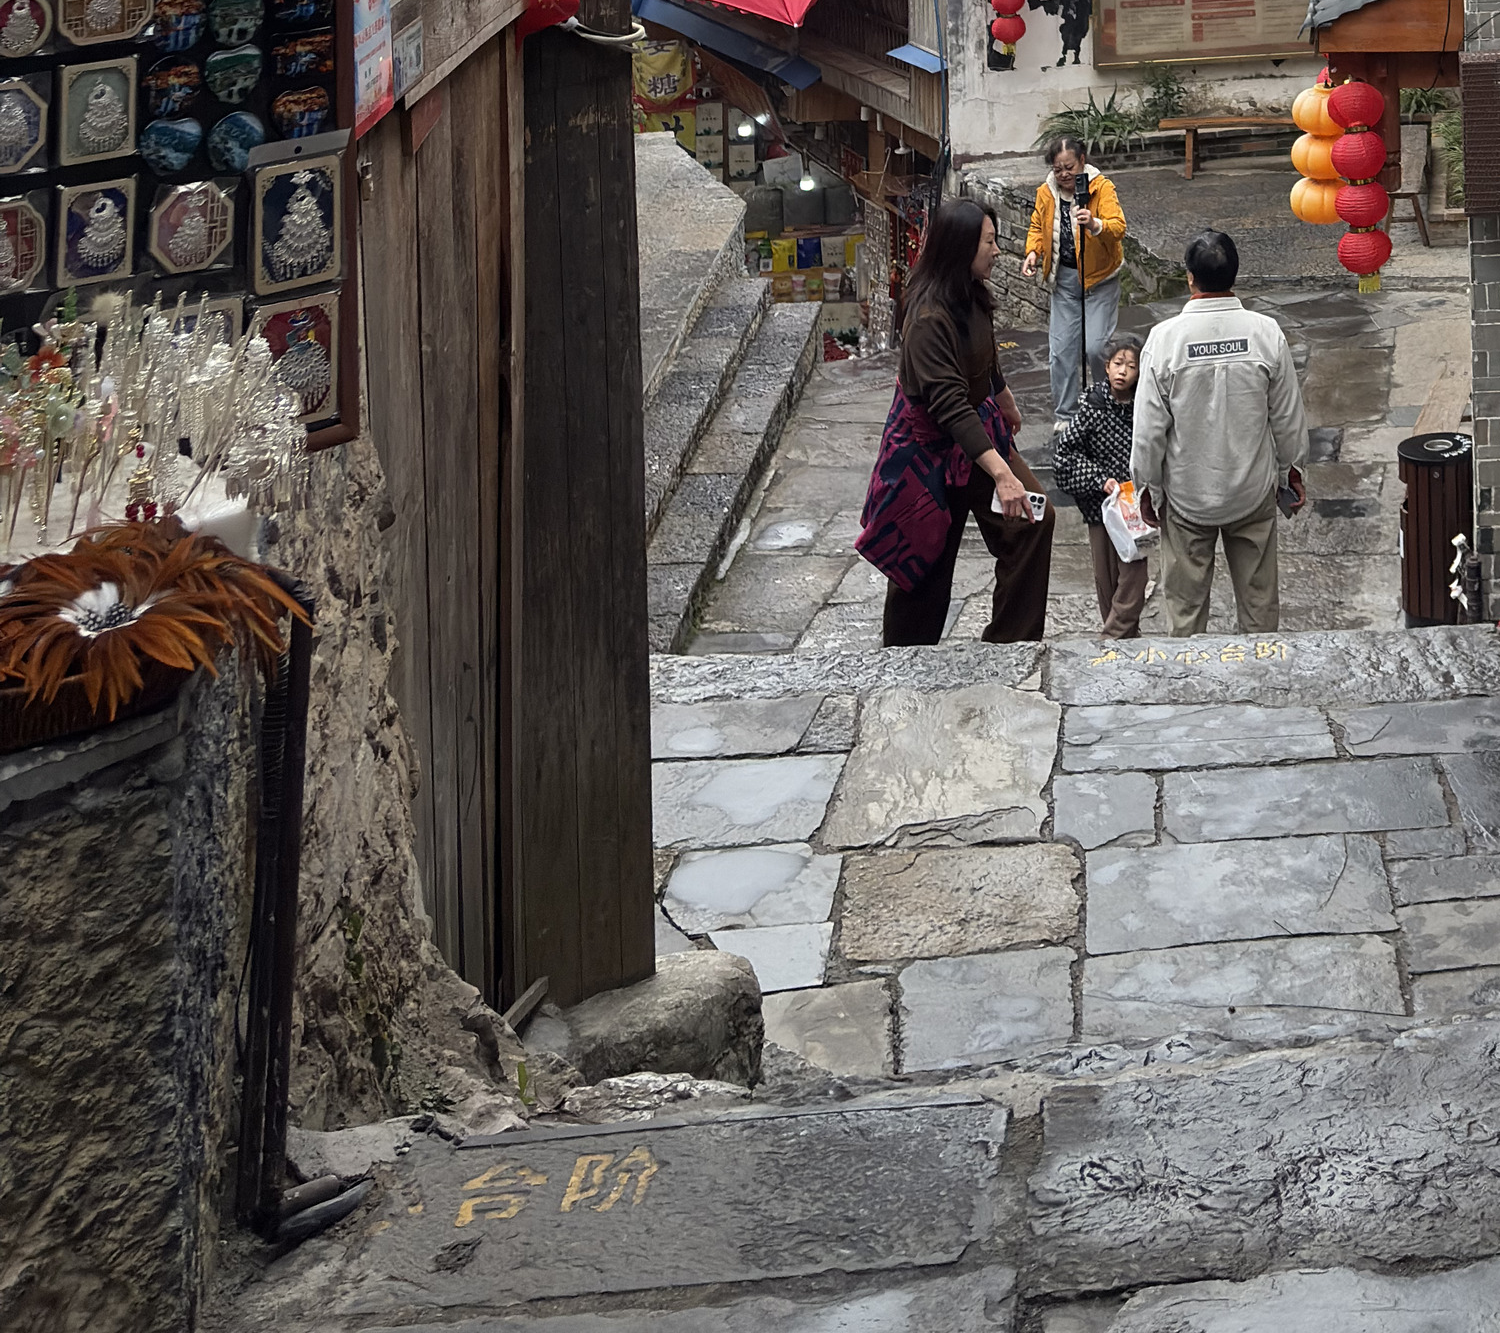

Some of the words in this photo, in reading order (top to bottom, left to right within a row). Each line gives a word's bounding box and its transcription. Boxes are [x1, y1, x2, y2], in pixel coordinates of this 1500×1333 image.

[1193, 344, 1218, 356] YOUR
[1219, 341, 1244, 354] SOUL
[1134, 640, 1287, 666] 小心台阶
[454, 1144, 661, 1228] 台阶
